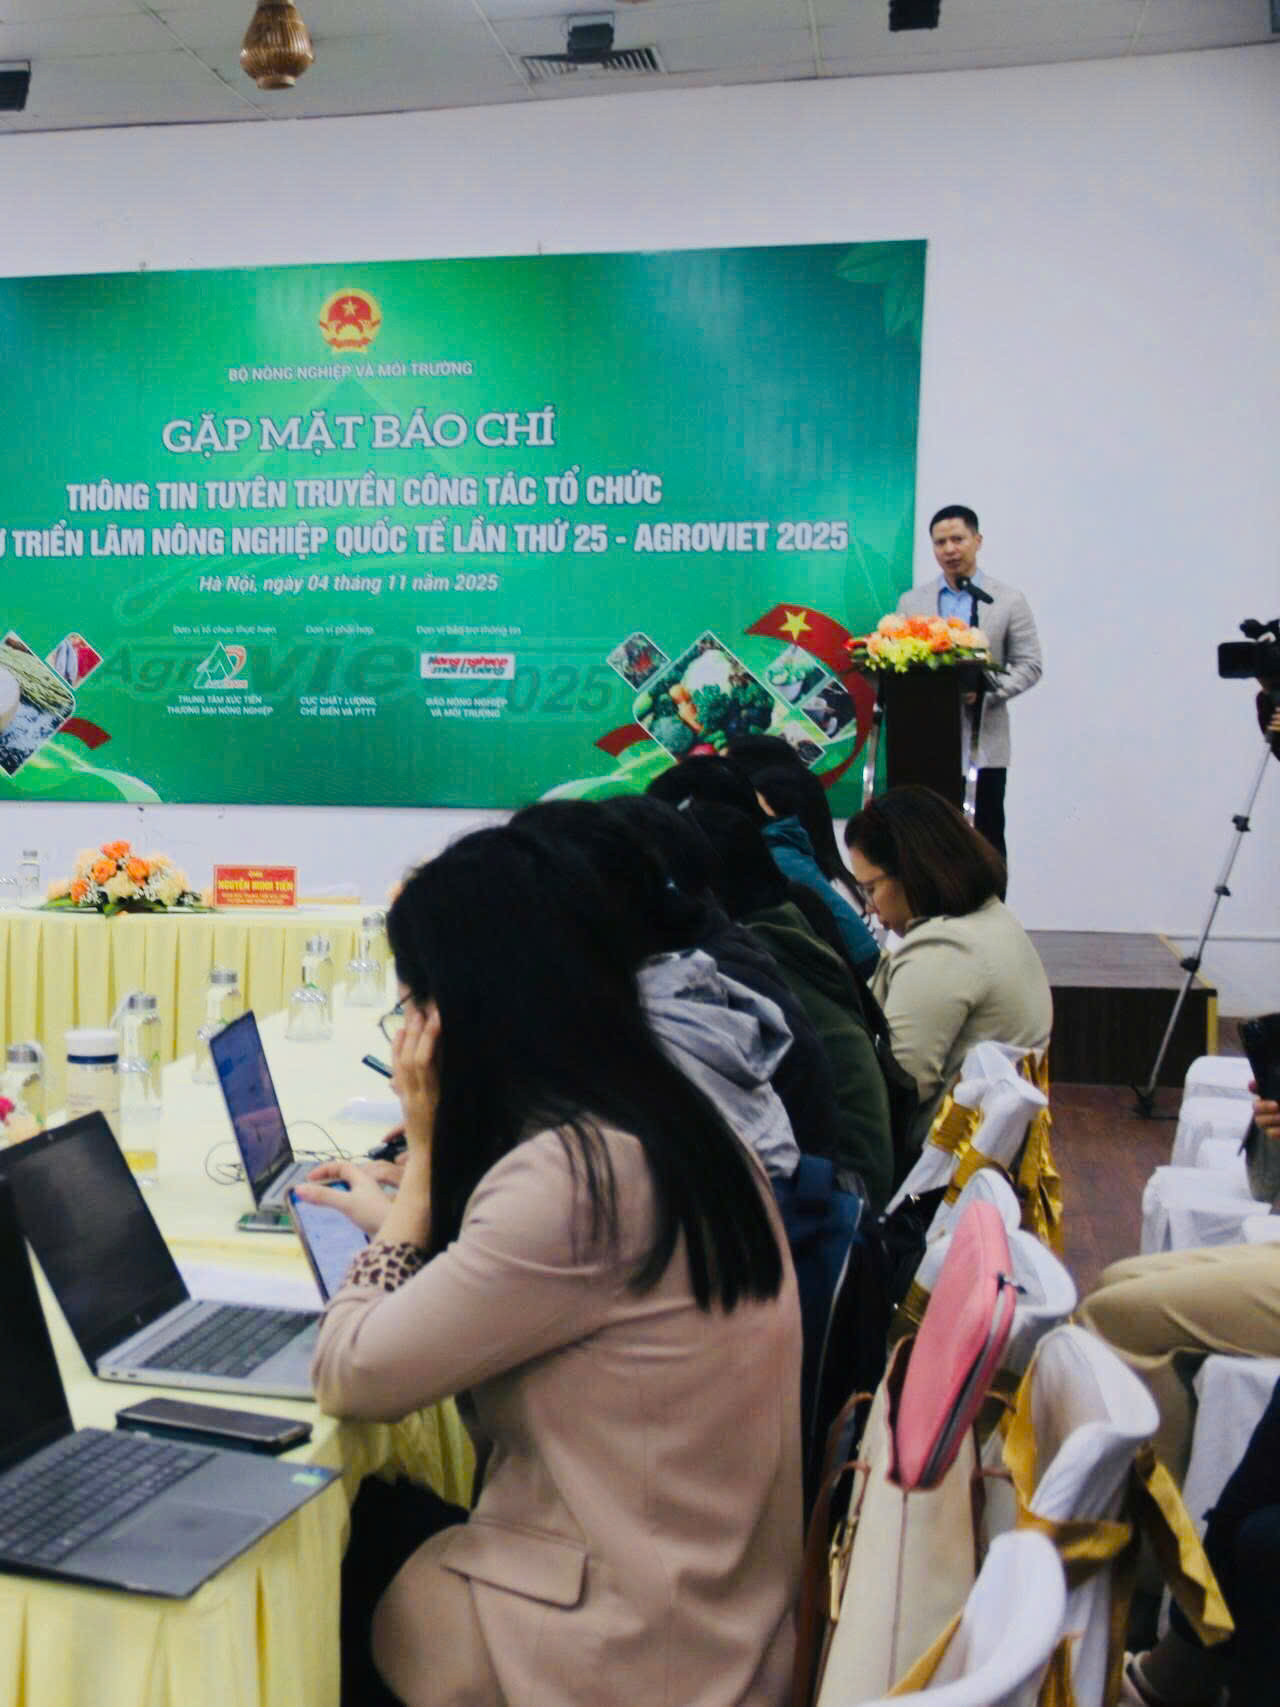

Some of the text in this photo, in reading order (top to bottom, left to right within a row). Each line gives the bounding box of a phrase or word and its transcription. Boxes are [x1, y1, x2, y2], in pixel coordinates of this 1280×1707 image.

[228, 359, 473, 384] BỘ NÔNG NGHIỆP VÀ MÔI TRƯỜNG
[162, 404, 555, 458] GẶP MẶT BÁO CHÍ
[66, 465, 662, 511] THÔNG TIN TUYÊN TRUYỀN CÔNG TÁC TỔ CHỨC
[13, 520, 84, 557] TRIỂN
[91, 524, 145, 556] LÃM
[152, 522, 225, 555] NÔNG
[231, 521, 329, 560] NGHIỆP
[335, 516, 407, 557] QUỐC
[415, 516, 448, 553] TẾ
[453, 516, 506, 553] LẦN
[514, 518, 569, 553] THỨ
[574, 524, 608, 553] 25
[634, 522, 769, 553] AGROVIET
[777, 521, 849, 552] 2025
[199, 575, 223, 591] Hà
[263, 574, 304, 595] ngày
[307, 575, 329, 591] 04
[334, 573, 382, 595] tháng
[387, 575, 407, 590] 11
[412, 572, 450, 591] năm
[455, 573, 498, 591] 2025
